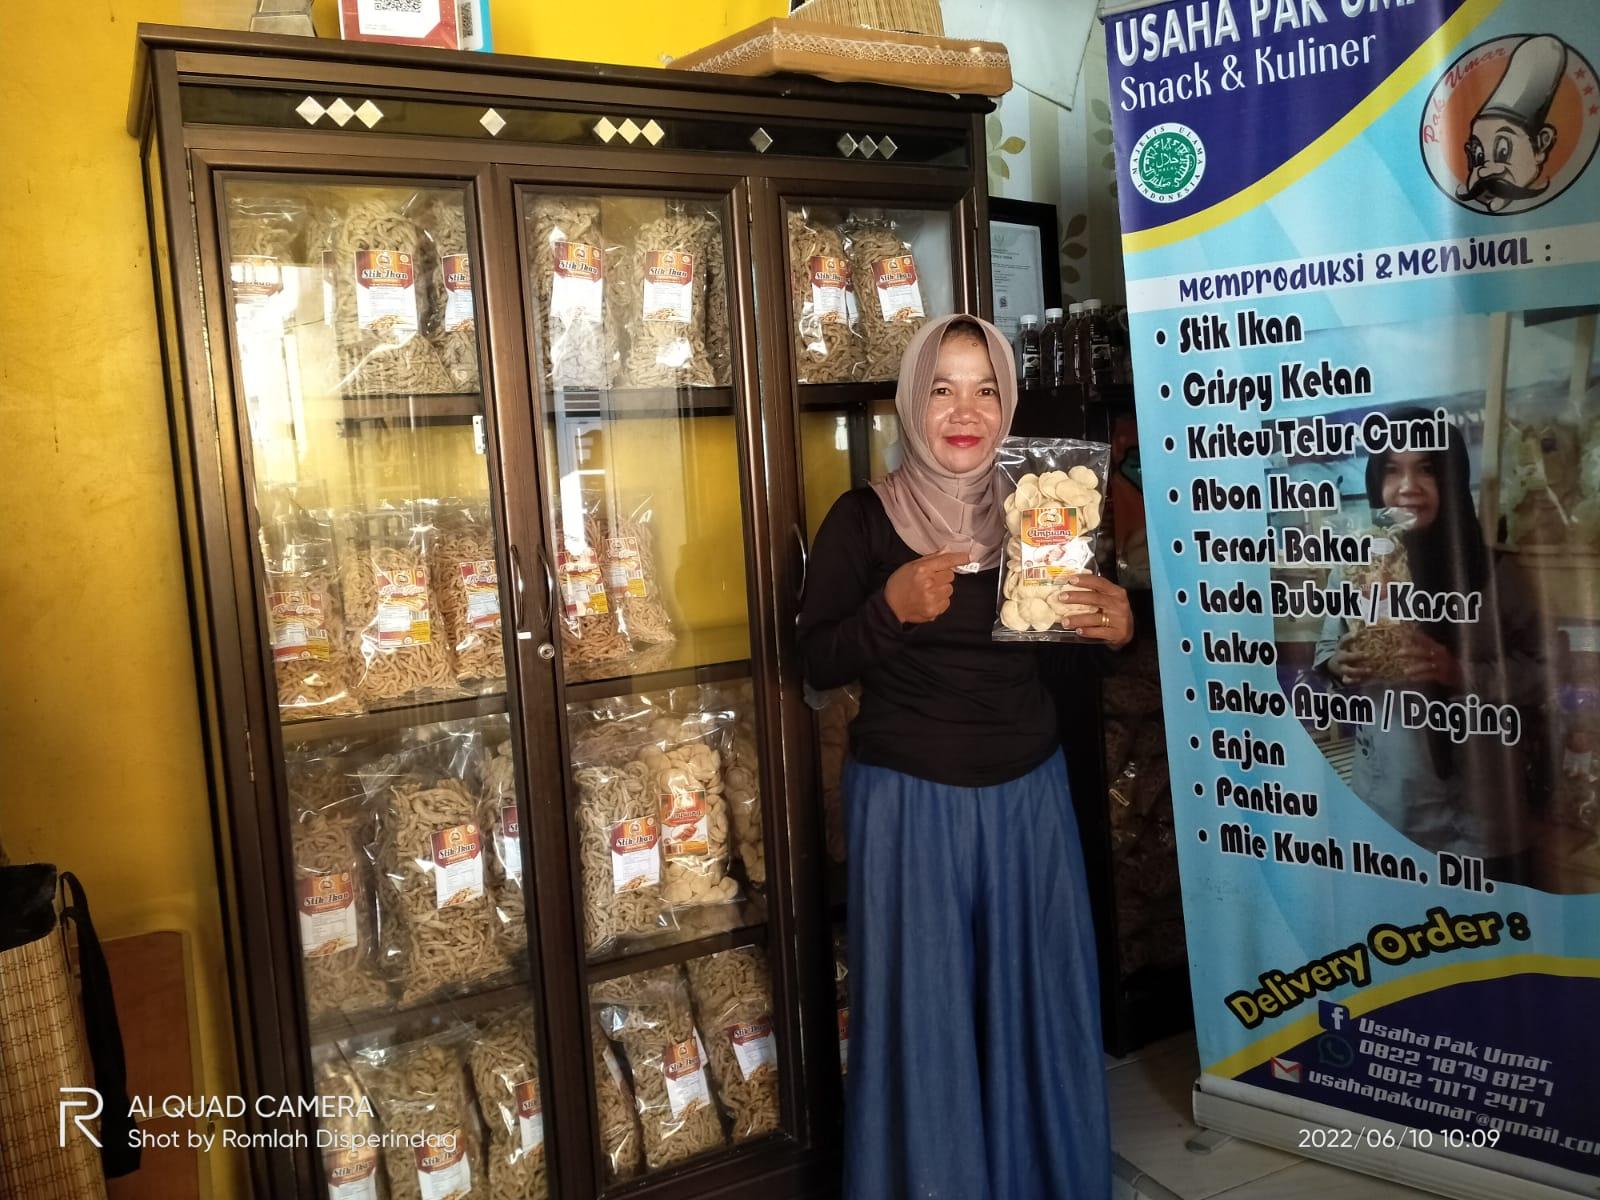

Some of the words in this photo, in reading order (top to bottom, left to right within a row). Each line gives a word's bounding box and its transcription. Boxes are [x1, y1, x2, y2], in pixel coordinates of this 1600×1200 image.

[1115, 0, 1241, 66] USAHA
[1251, 0, 1329, 38] PAK
[1120, 61, 1213, 112] Snack
[1220, 54, 1246, 92] &
[1256, 34, 1377, 85] Kuliner
[1131, 126, 1166, 176] MAJELIS
[1178, 126, 1204, 166] ULAMA
[1137, 173, 1202, 202] INDONESIA
[1375, 253, 1393, 280] &
[1180, 312, 1231, 354] Stik
[1238, 311, 1303, 348] Ikan
[1183, 369, 1273, 411] Crispy
[1281, 361, 1372, 399] Ketan
[1187, 424, 1273, 459] Kritcu
[1278, 416, 1354, 456] Telur
[1363, 408, 1449, 453] Cumi
[1191, 476, 1262, 512] Abon
[1270, 475, 1336, 510] Ikan
[1194, 528, 1275, 564] Terasi
[1284, 528, 1373, 564] Bakar
[1199, 582, 1263, 616] Lada
[1270, 581, 1363, 617] Bubuk
[1368, 583, 1380, 624] /
[1389, 583, 1482, 622] Kasar
[1203, 633, 1276, 667] Lakso
[1207, 681, 1286, 717] Bakso
[1292, 684, 1374, 729] Ayam
[1383, 690, 1394, 732] /
[1402, 691, 1521, 745] Daging
[1212, 730, 1286, 770] Enjan
[1216, 776, 1319, 818] Pantiau
[1220, 823, 1267, 858] Mie
[1273, 831, 1344, 871] Kuah
[1227, 946, 1369, 1027] Delivery
[1370, 909, 1500, 963] Order
[1358, 1017, 1430, 1048] Usaha
[1434, 1035, 1479, 1058] Pak
[1483, 1046, 1553, 1072] Umar
[1359, 1039, 1421, 1067] 0822
[1426, 1054, 1489, 1082] 7879
[1492, 1071, 1554, 1097] 8127
[1368, 1062, 1422, 1088] 0812
[1427, 1077, 1477, 1101] 7117
[1484, 1091, 1546, 1118] 2417
